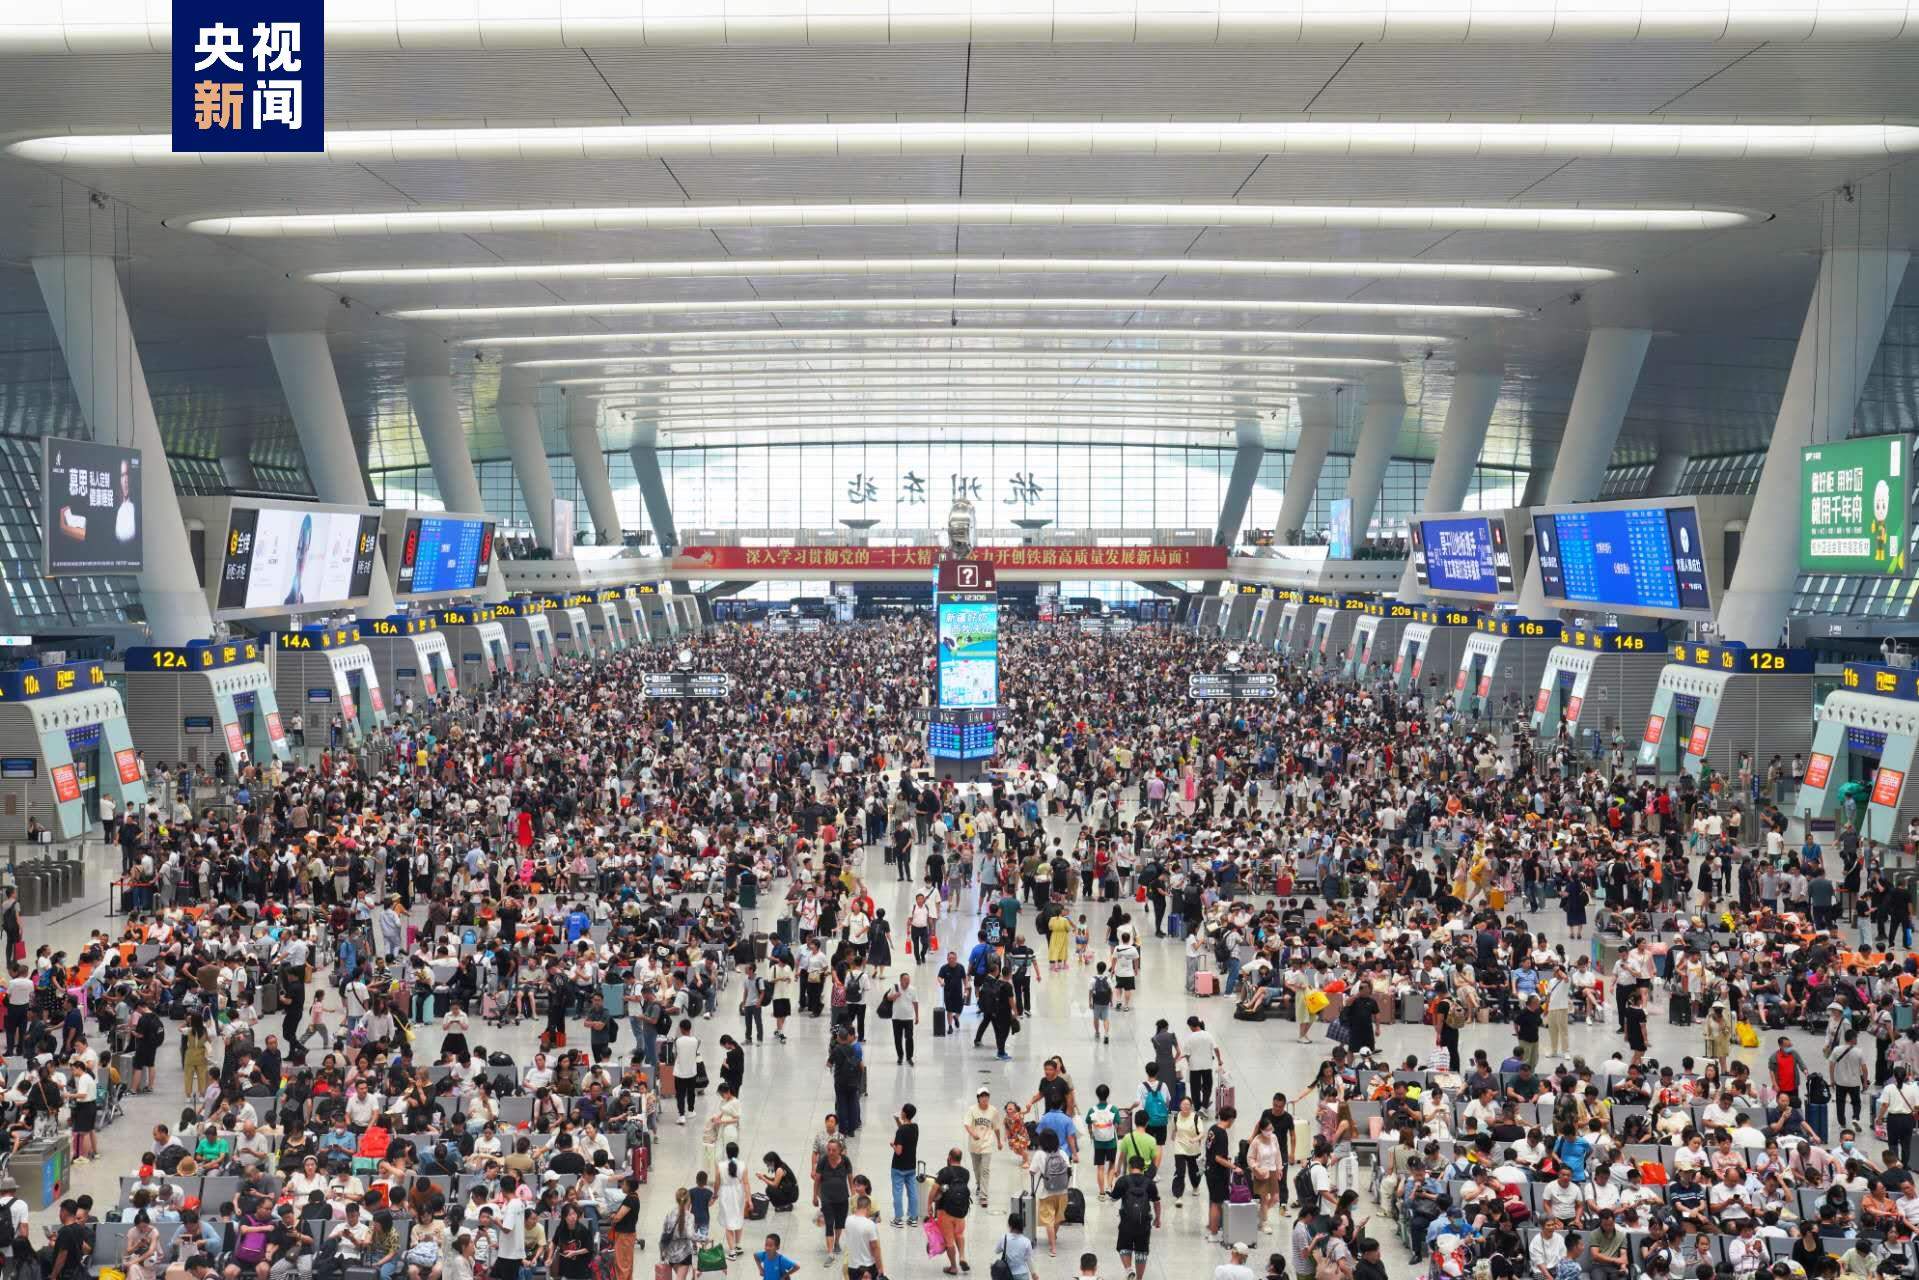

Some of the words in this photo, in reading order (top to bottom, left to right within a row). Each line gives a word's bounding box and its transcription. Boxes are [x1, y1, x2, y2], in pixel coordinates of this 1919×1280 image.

[745, 549, 933, 566] 深入学习贯彻党的二十大精
[496, 605, 516, 616] 20A
[1345, 599, 1364, 609] 22B
[1391, 606, 1411, 616] 20B
[443, 612, 465, 624] 18A
[1446, 613, 1469, 624] 18B
[373, 622, 398, 634] 16A
[1518, 622, 1544, 635] 16B
[281, 634, 311, 648] 14A
[1614, 635, 1644, 649] 14B
[152, 651, 187, 668] 12A
[1750, 652, 1785, 669] 12B
[24, 674, 41, 695] 10A
[90, 665, 104, 684] 11A
